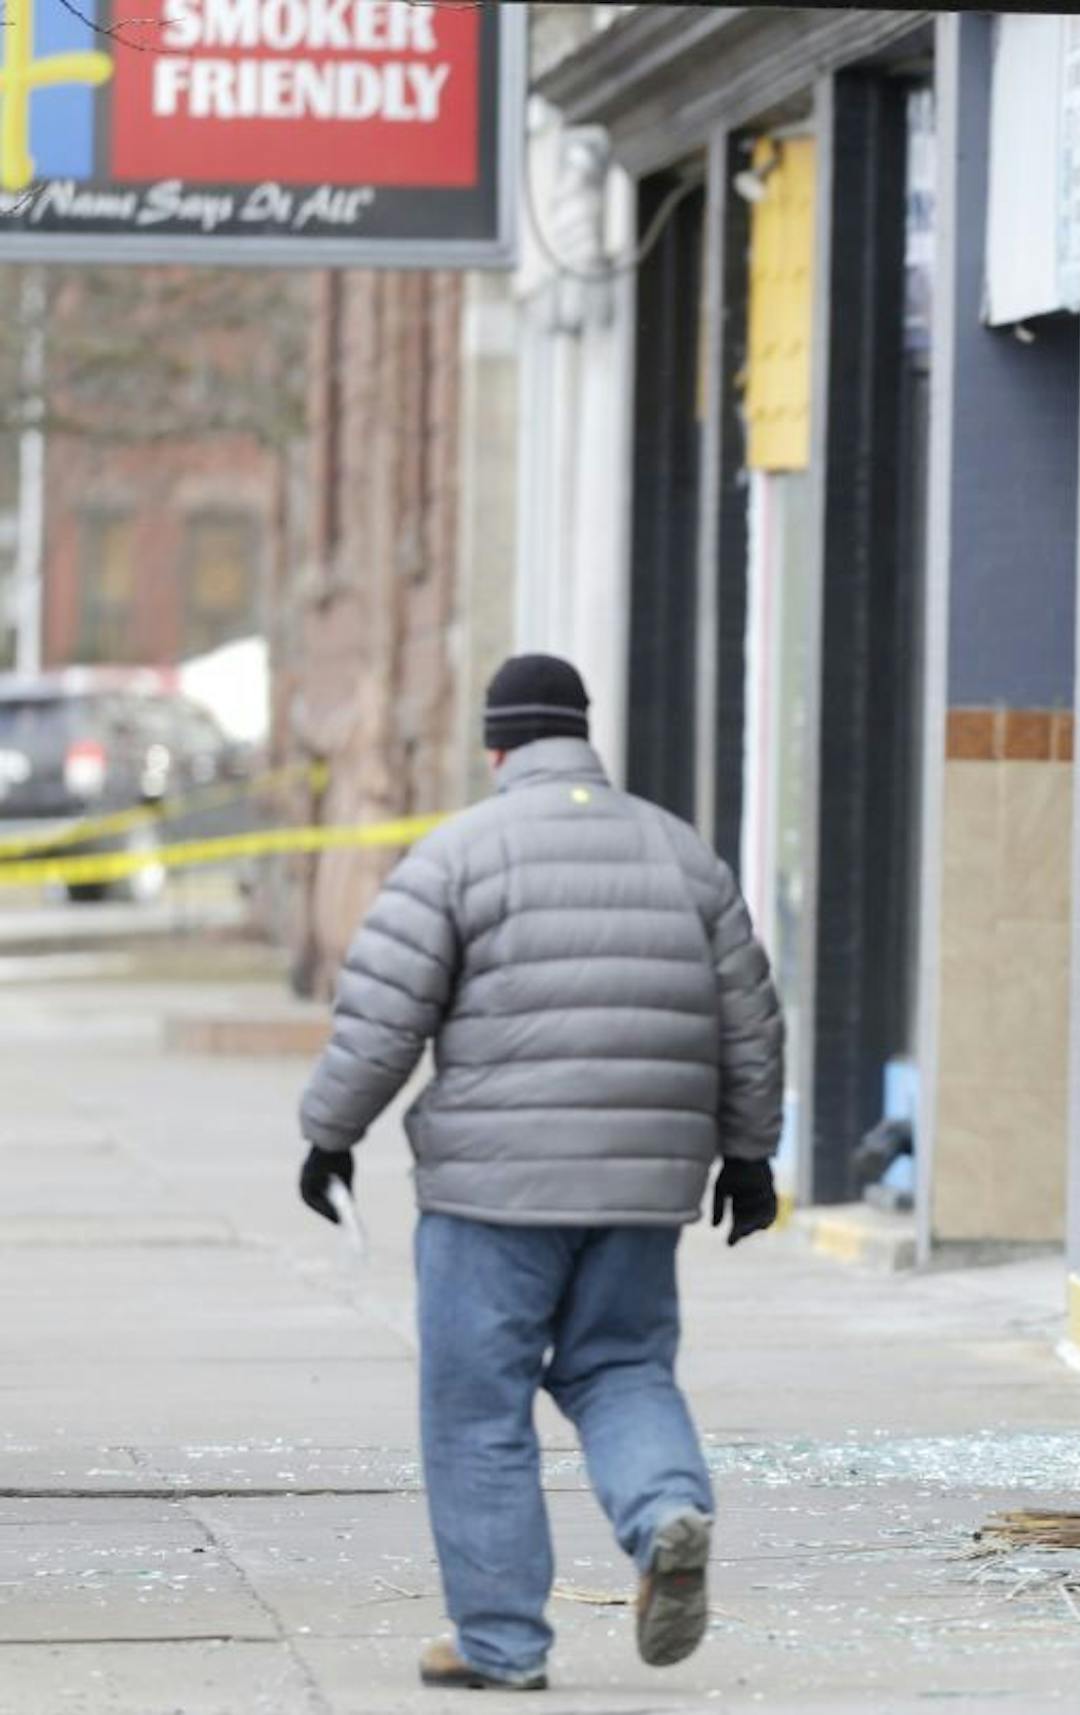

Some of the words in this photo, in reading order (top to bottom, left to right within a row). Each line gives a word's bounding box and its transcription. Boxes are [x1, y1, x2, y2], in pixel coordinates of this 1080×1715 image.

[162, 0, 437, 52] SMOKER
[152, 57, 450, 121] FRIENDLY
[136, 179, 233, 231] Says
